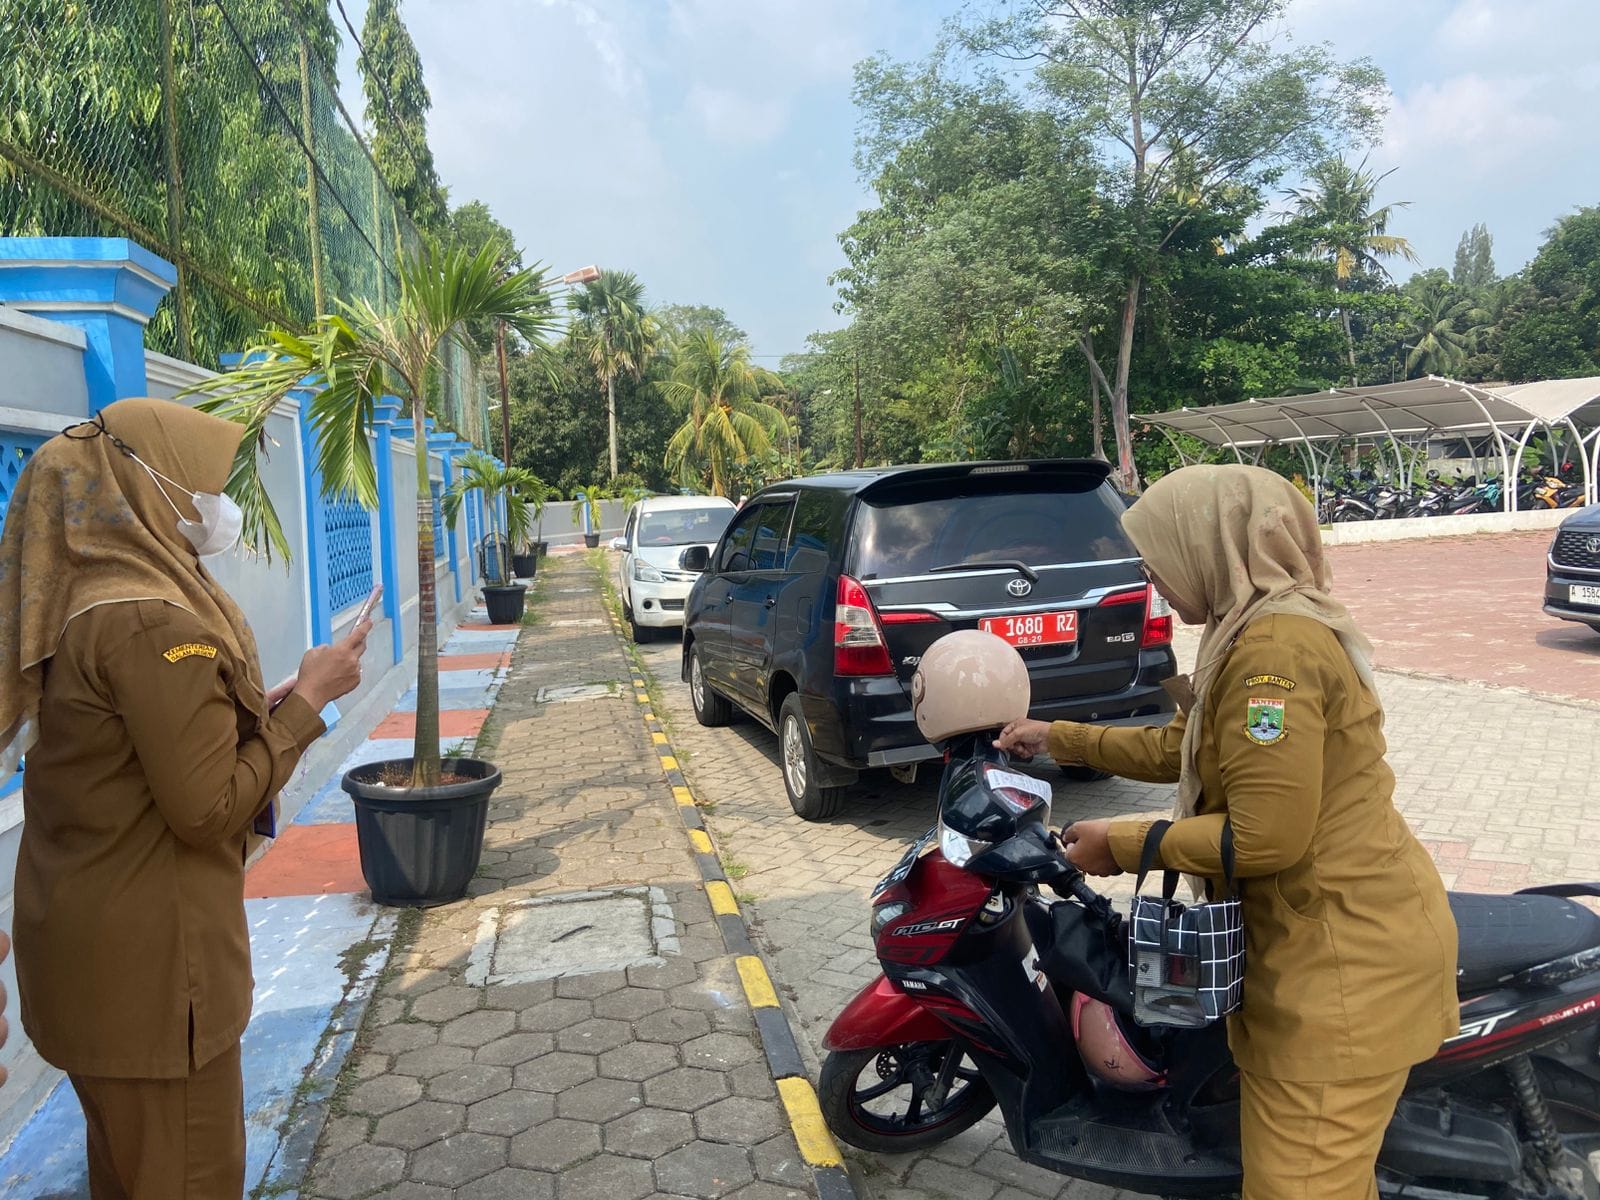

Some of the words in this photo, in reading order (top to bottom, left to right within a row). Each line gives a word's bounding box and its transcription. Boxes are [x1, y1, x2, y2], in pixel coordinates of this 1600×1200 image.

[1572, 586, 1576, 595] A
[984, 620, 993, 633] A
[1006, 617, 1043, 636] 1680
[1056, 613, 1075, 631] RZ
[166, 643, 216, 657] KEMENTERIAN
[902, 980, 927, 990] YAMAHA
